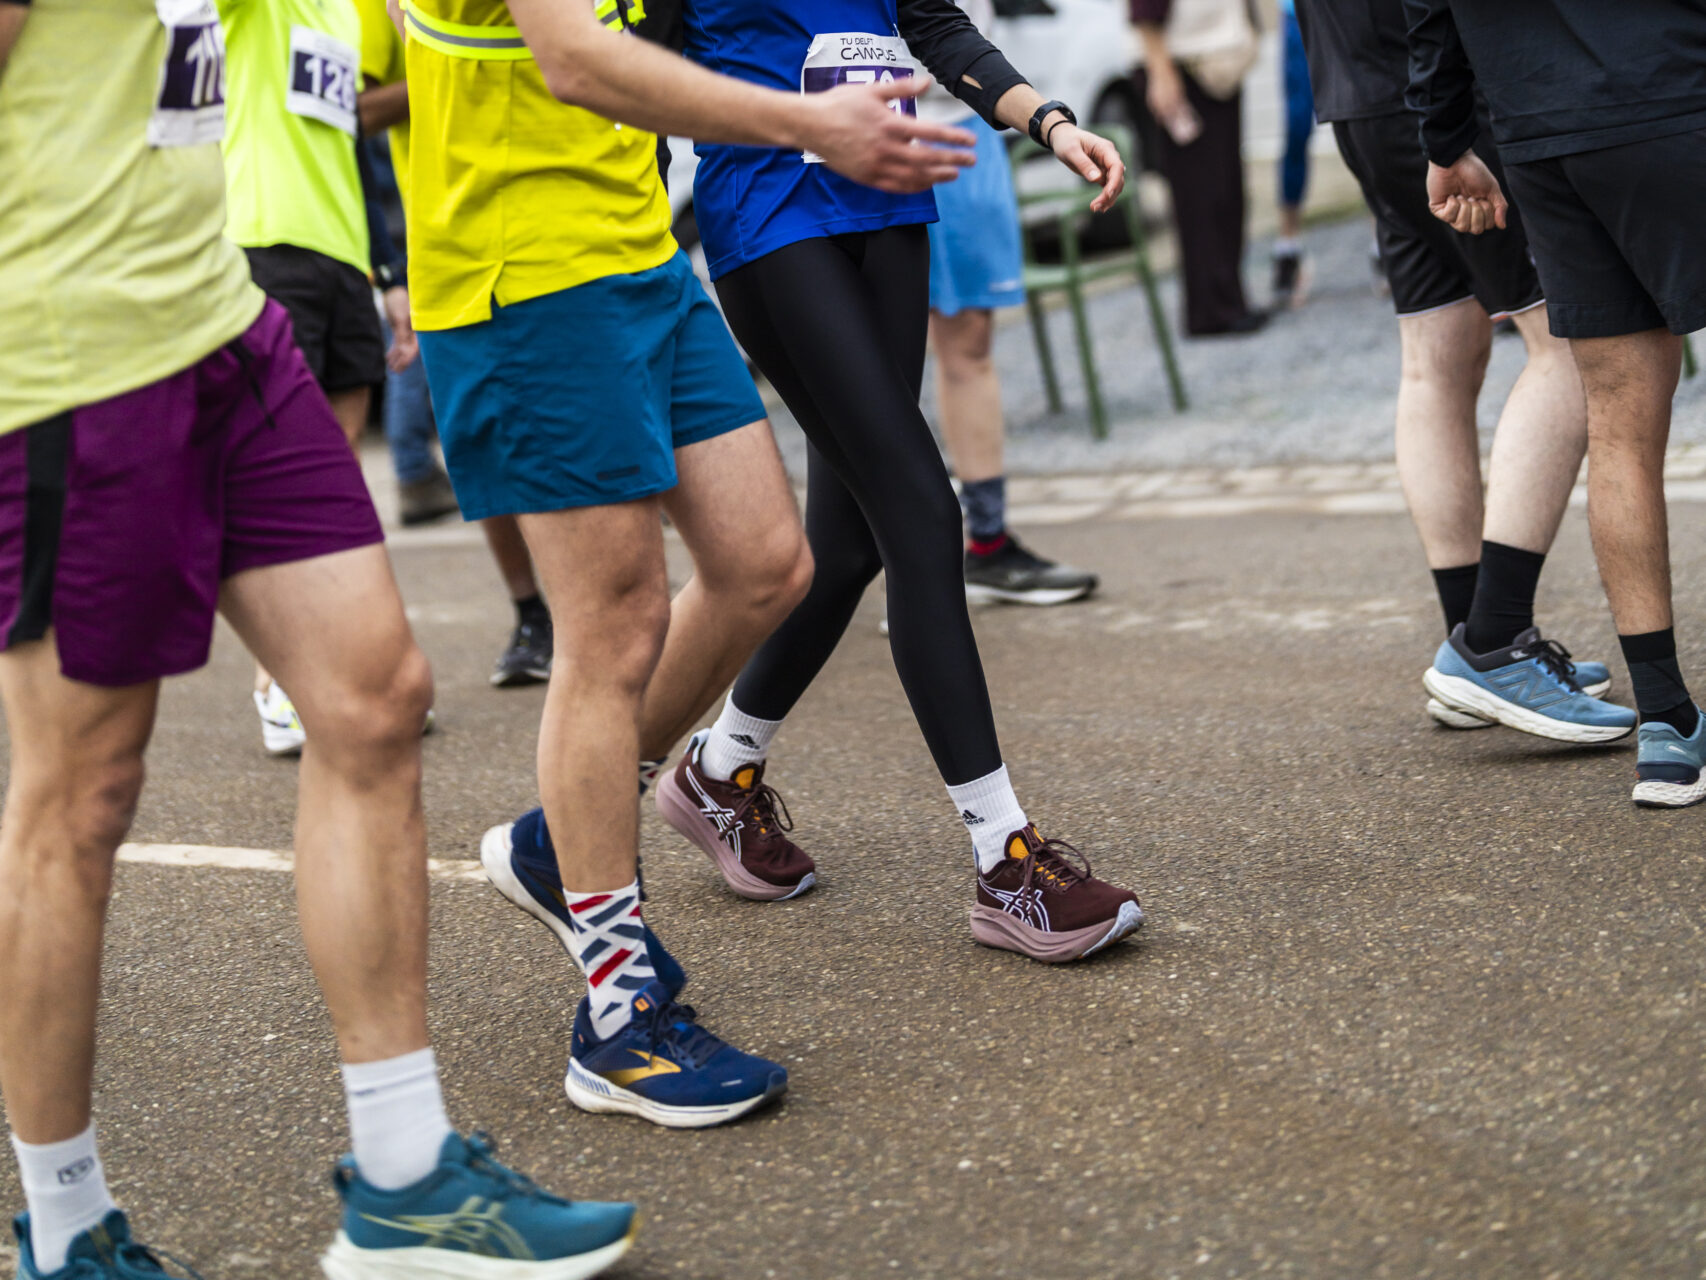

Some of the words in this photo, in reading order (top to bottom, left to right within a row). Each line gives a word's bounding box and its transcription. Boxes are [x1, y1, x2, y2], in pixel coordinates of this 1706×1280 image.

[840, 37, 853, 46] TU
[855, 37, 874, 47] DELFT
[840, 47, 897, 62] CAMPUS
